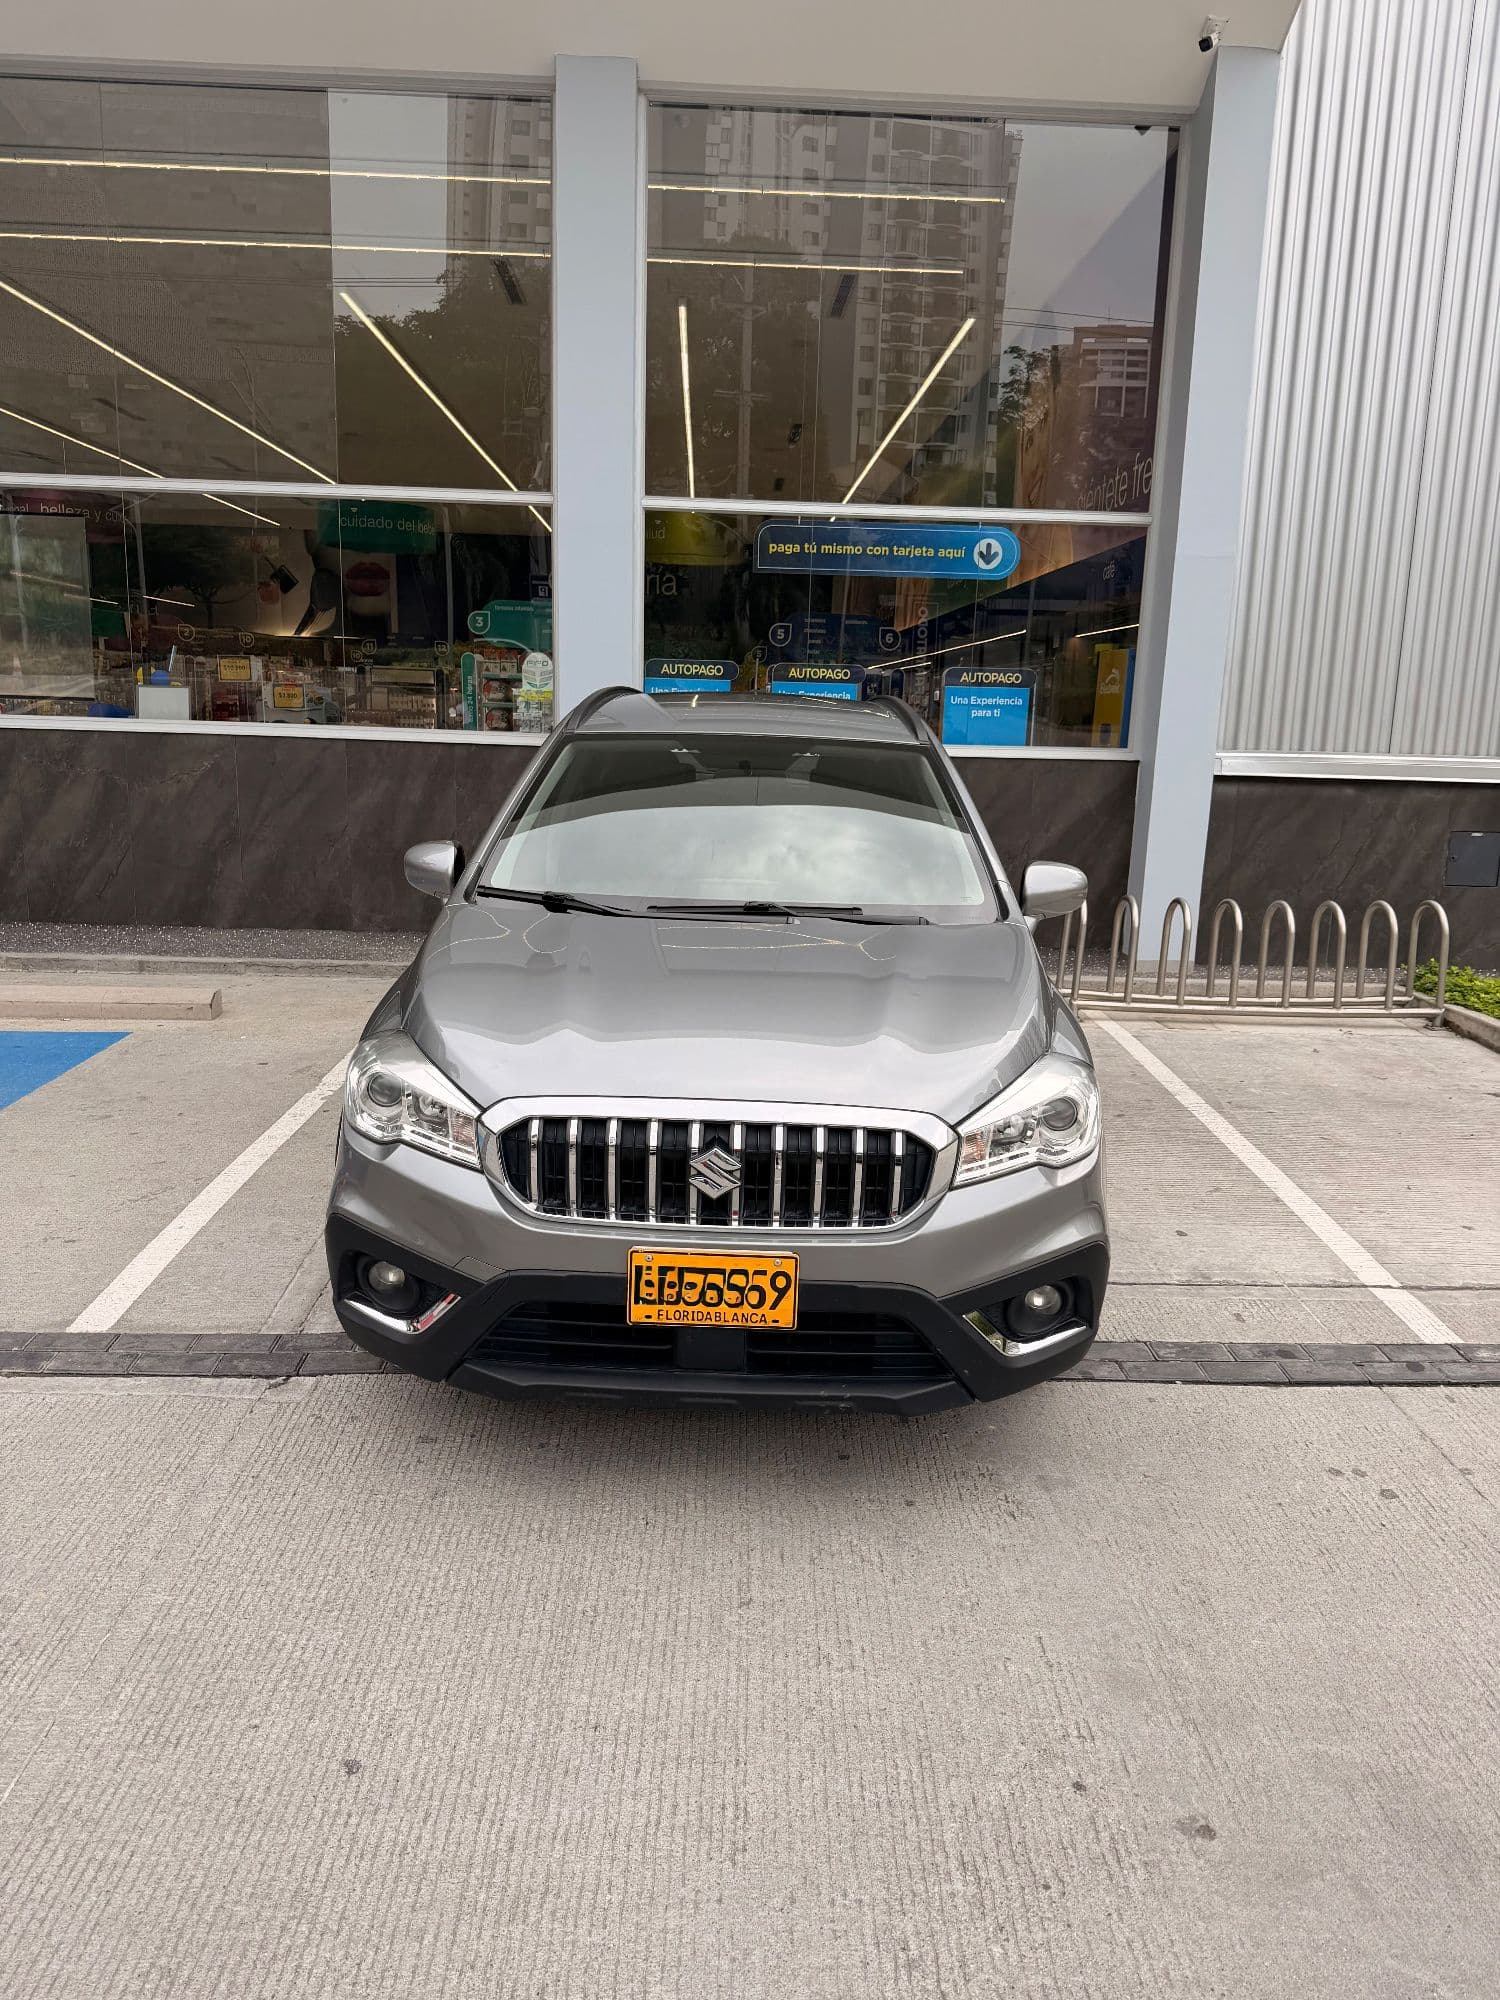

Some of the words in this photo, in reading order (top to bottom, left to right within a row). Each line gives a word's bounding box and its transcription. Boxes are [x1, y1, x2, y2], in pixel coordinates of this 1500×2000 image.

[340, 515, 393, 529] cuidado
[397, 518, 415, 533] del
[768, 542, 801, 555] paga
[803, 541, 817, 554] tú
[820, 543, 863, 556] mismo
[866, 545, 889, 556] con
[893, 544, 934, 558] tarjeta
[937, 546, 966, 559] aquí
[475, 617, 484, 628] 3
[184, 628, 191, 637] 2
[777, 629, 785, 640] 5
[886, 633, 894, 644] 6
[660, 663, 724, 676] AUTOPAGO
[788, 667, 851, 680] AUTOPAGO
[960, 671, 1022, 684] AUTOPAGO
[950, 695, 969, 705] Una
[970, 696, 1023, 707] Experiencia
[971, 708, 992, 719] para
[993, 708, 1001, 718] ti
[656, 1309, 768, 1324] FLORIDABLANCA
